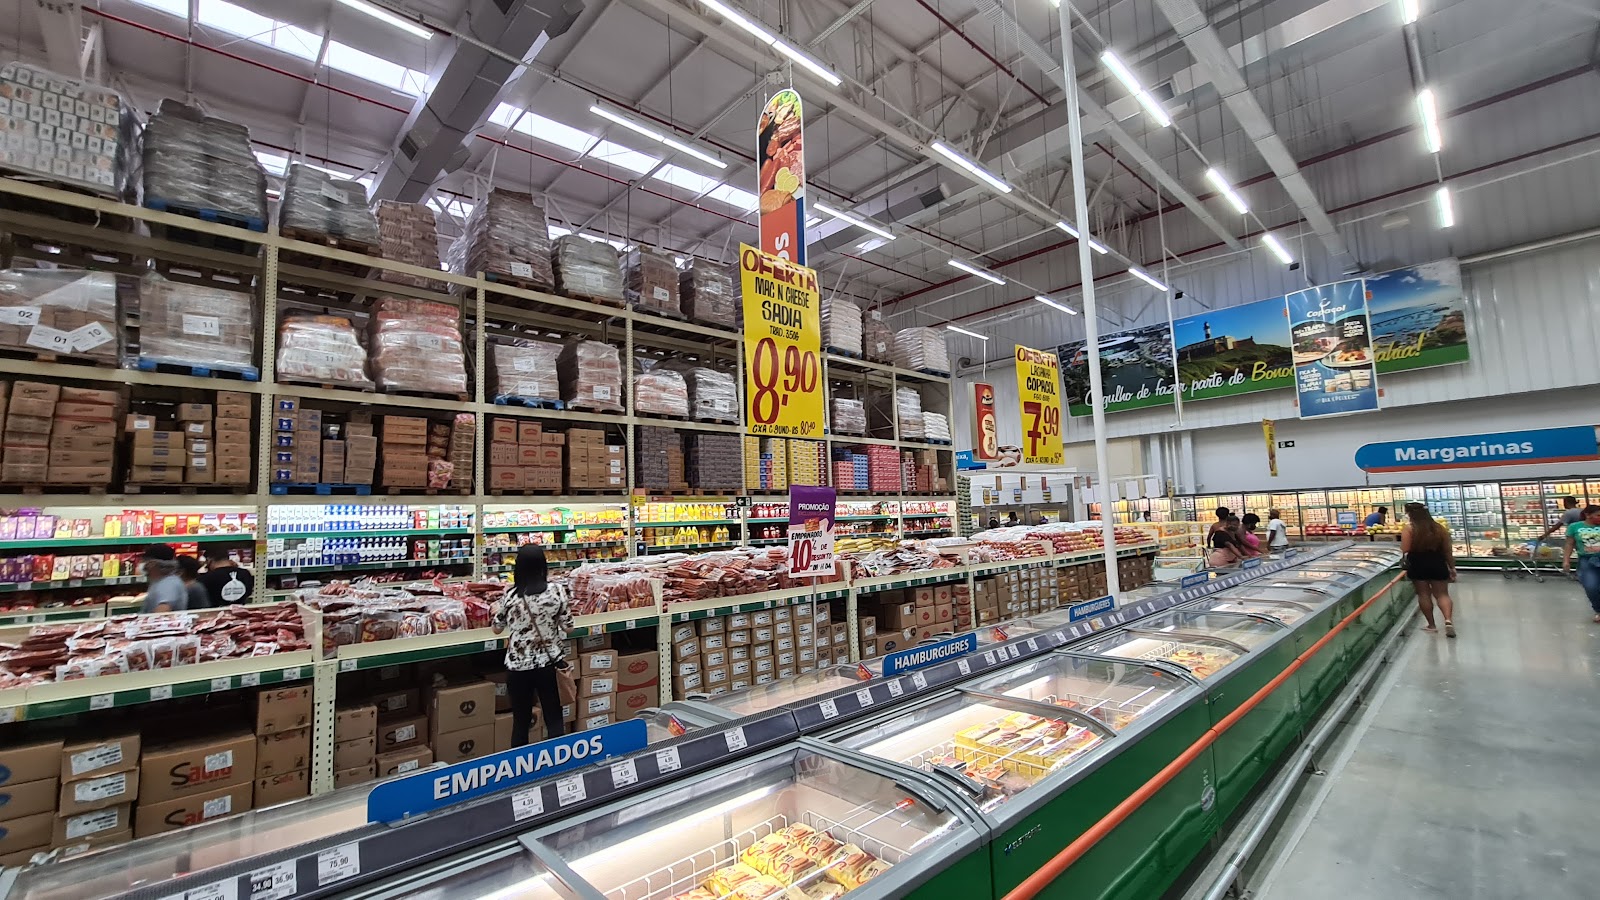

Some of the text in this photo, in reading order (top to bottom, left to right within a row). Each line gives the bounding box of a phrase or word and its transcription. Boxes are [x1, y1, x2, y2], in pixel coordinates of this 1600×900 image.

[742, 249, 818, 293] OFERTA
[755, 276, 810, 309] MAC N CHEESE
[18, 310, 33, 319] 02
[761, 300, 803, 330] SADIA
[54, 336, 67, 345] 01
[1136, 383, 1151, 400] de
[1190, 371, 1224, 397] parte
[1228, 367, 1245, 386] de
[752, 424, 767, 434] CXA
[1394, 441, 1534, 463] Margarinas
[798, 502, 830, 512] PROMOÇÃO
[791, 530, 823, 541] EMPANADOS
[820, 543, 828, 551] DE
[894, 638, 970, 670] HAMBURGUERES
[433, 734, 604, 800] EMPANADOS
